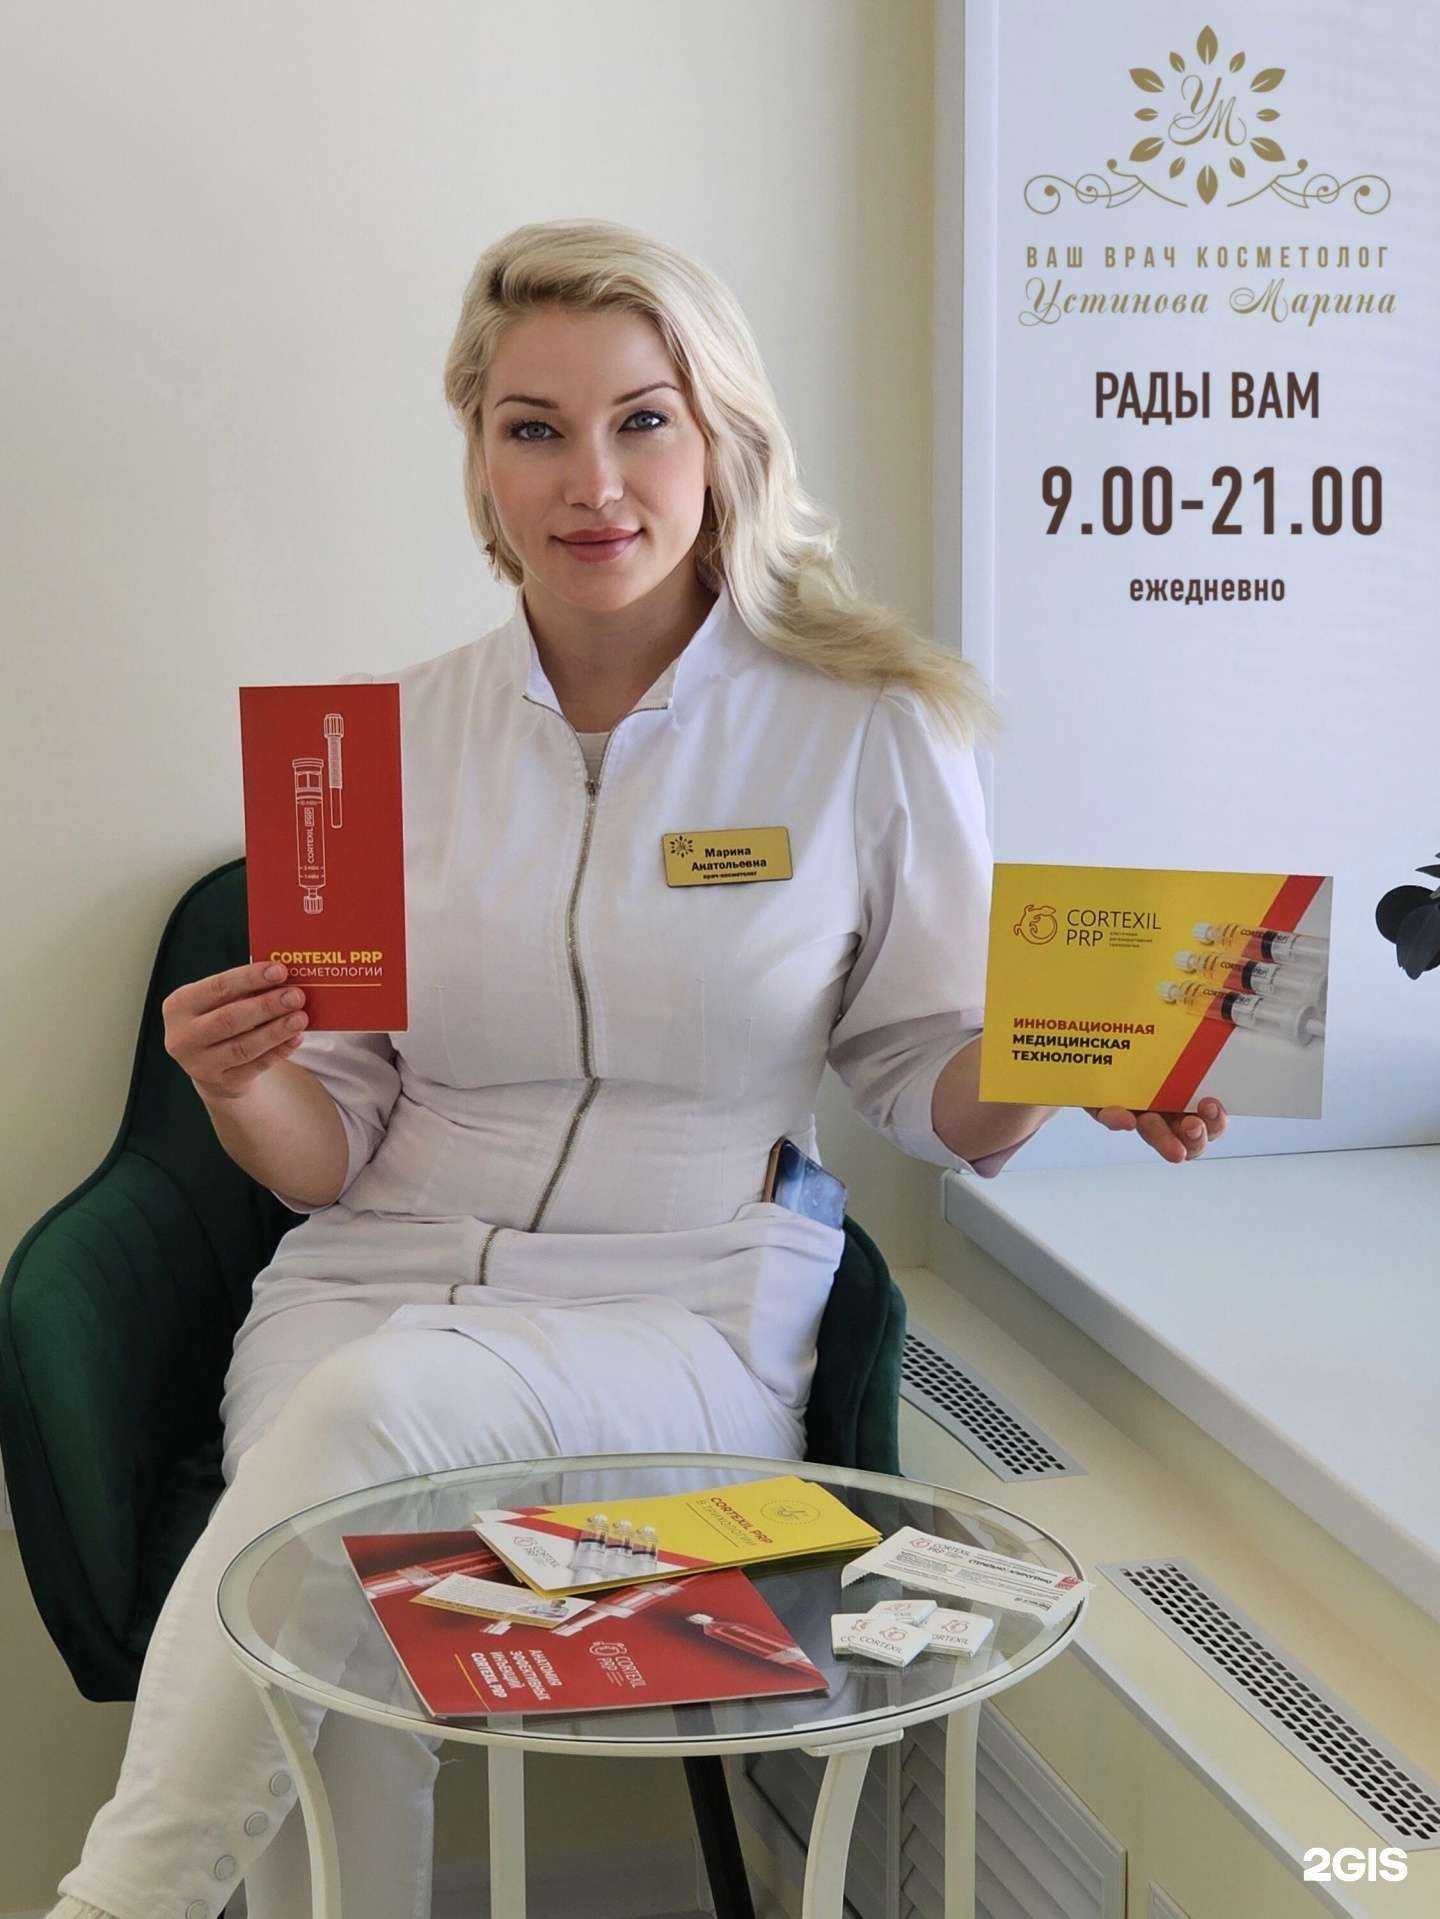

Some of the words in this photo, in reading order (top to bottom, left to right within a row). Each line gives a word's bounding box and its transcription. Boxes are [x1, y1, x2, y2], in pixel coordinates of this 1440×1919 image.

[1026, 246, 1083, 268] ВАШ
[1104, 246, 1176, 268] ВРАЧ
[1197, 246, 1390, 268] КОСМЕТОЛОГ
[1018, 277, 1209, 327] Устинова
[1229, 278, 1397, 327] Марина
[1095, 371, 1210, 426] РАДЫ
[1230, 371, 1320, 419] ВАМ
[1041, 464, 1384, 537] 9.00-21.00
[1129, 577, 1286, 606] ежедневно
[704, 847, 752, 859] Марина
[691, 858, 768, 872] Анатольевна
[1067, 909, 1162, 930] CORTEXIL
[1066, 929, 1104, 947] PRP
[270, 951, 347, 964] CORTEXIL
[350, 951, 384, 964] PRP
[1013, 1017, 1156, 1035] ИННОВАЦИОННАЯ
[1012, 1034, 1131, 1050] МЕДИЦИНСКАЯ
[1011, 1049, 1113, 1066] ТЕХНОЛОГИЯ
